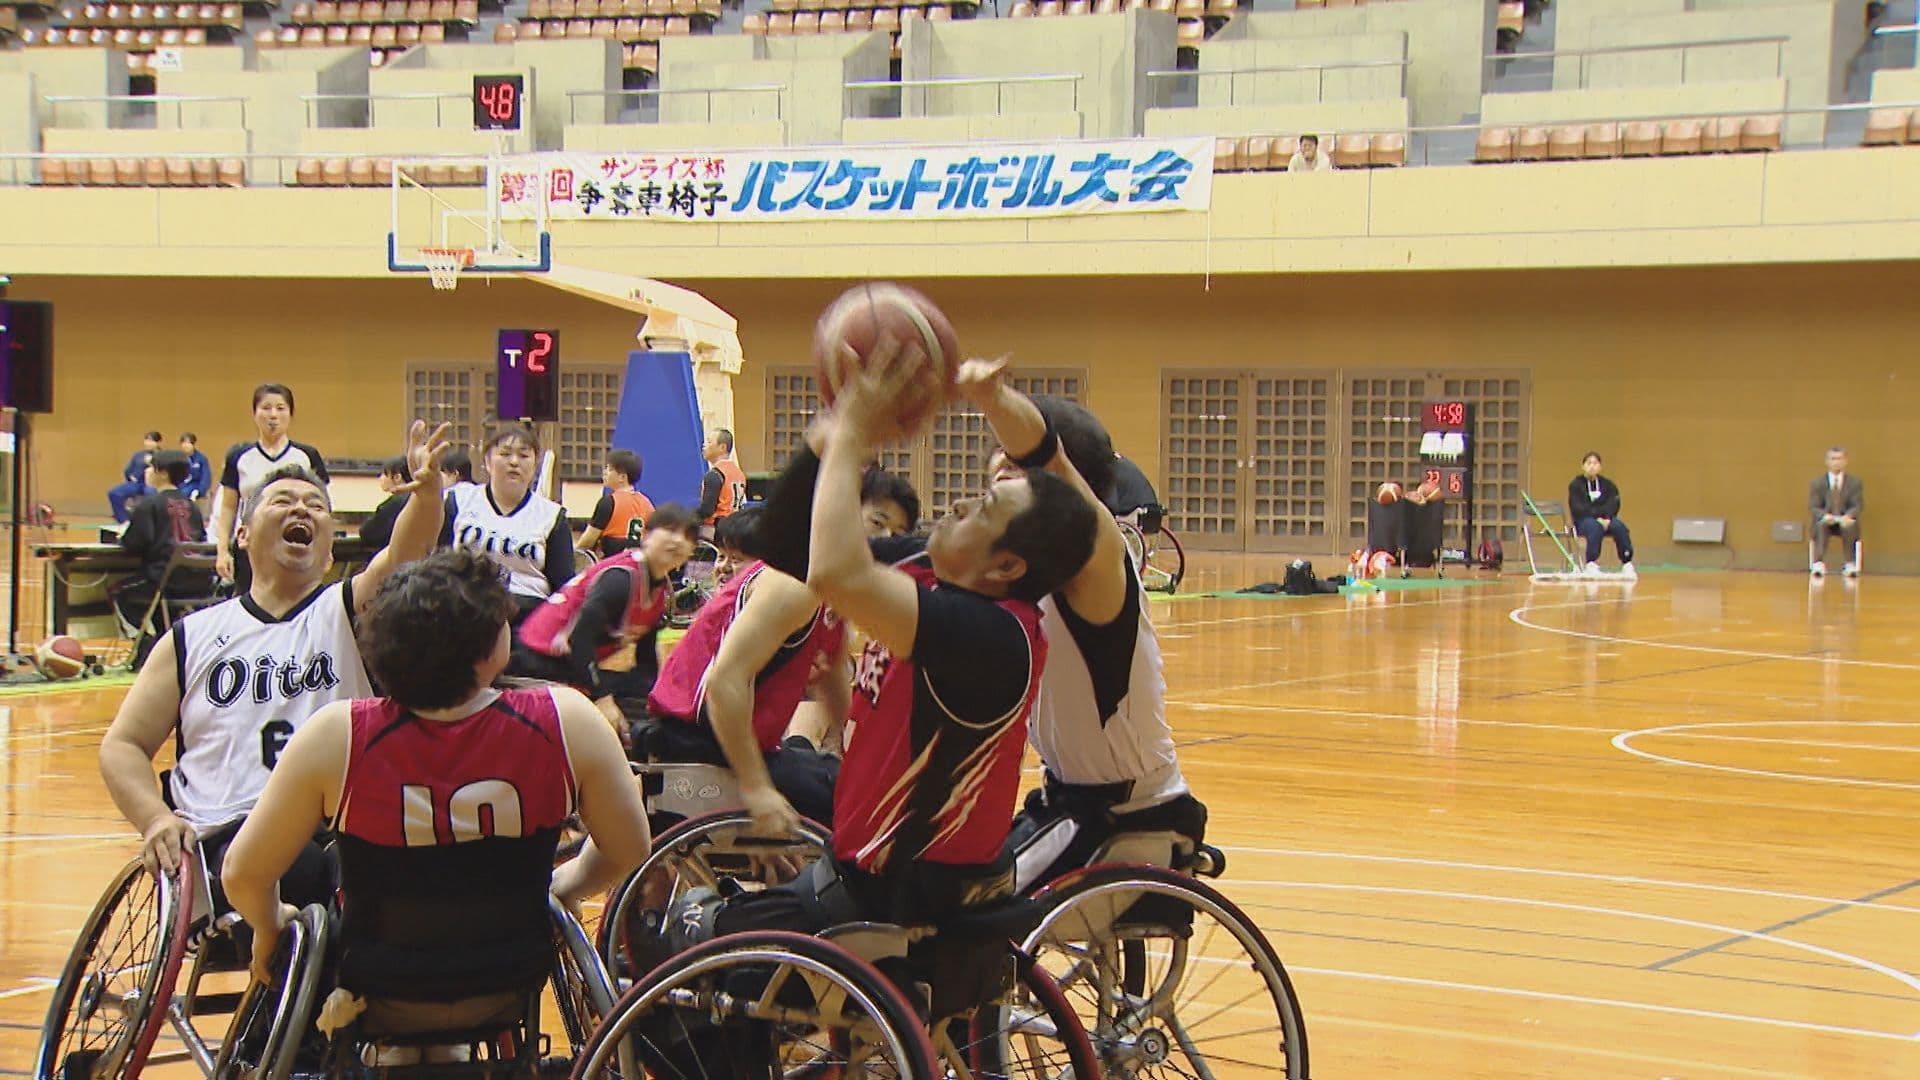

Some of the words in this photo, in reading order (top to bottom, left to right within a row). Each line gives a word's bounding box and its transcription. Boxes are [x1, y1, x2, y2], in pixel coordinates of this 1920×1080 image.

[600, 157, 725, 180] サンライズ杯
[731, 150, 1194, 212] バスケットボール大会
[503, 348, 523, 369] T
[527, 332, 552, 372] 2
[206, 651, 340, 708] Oita
